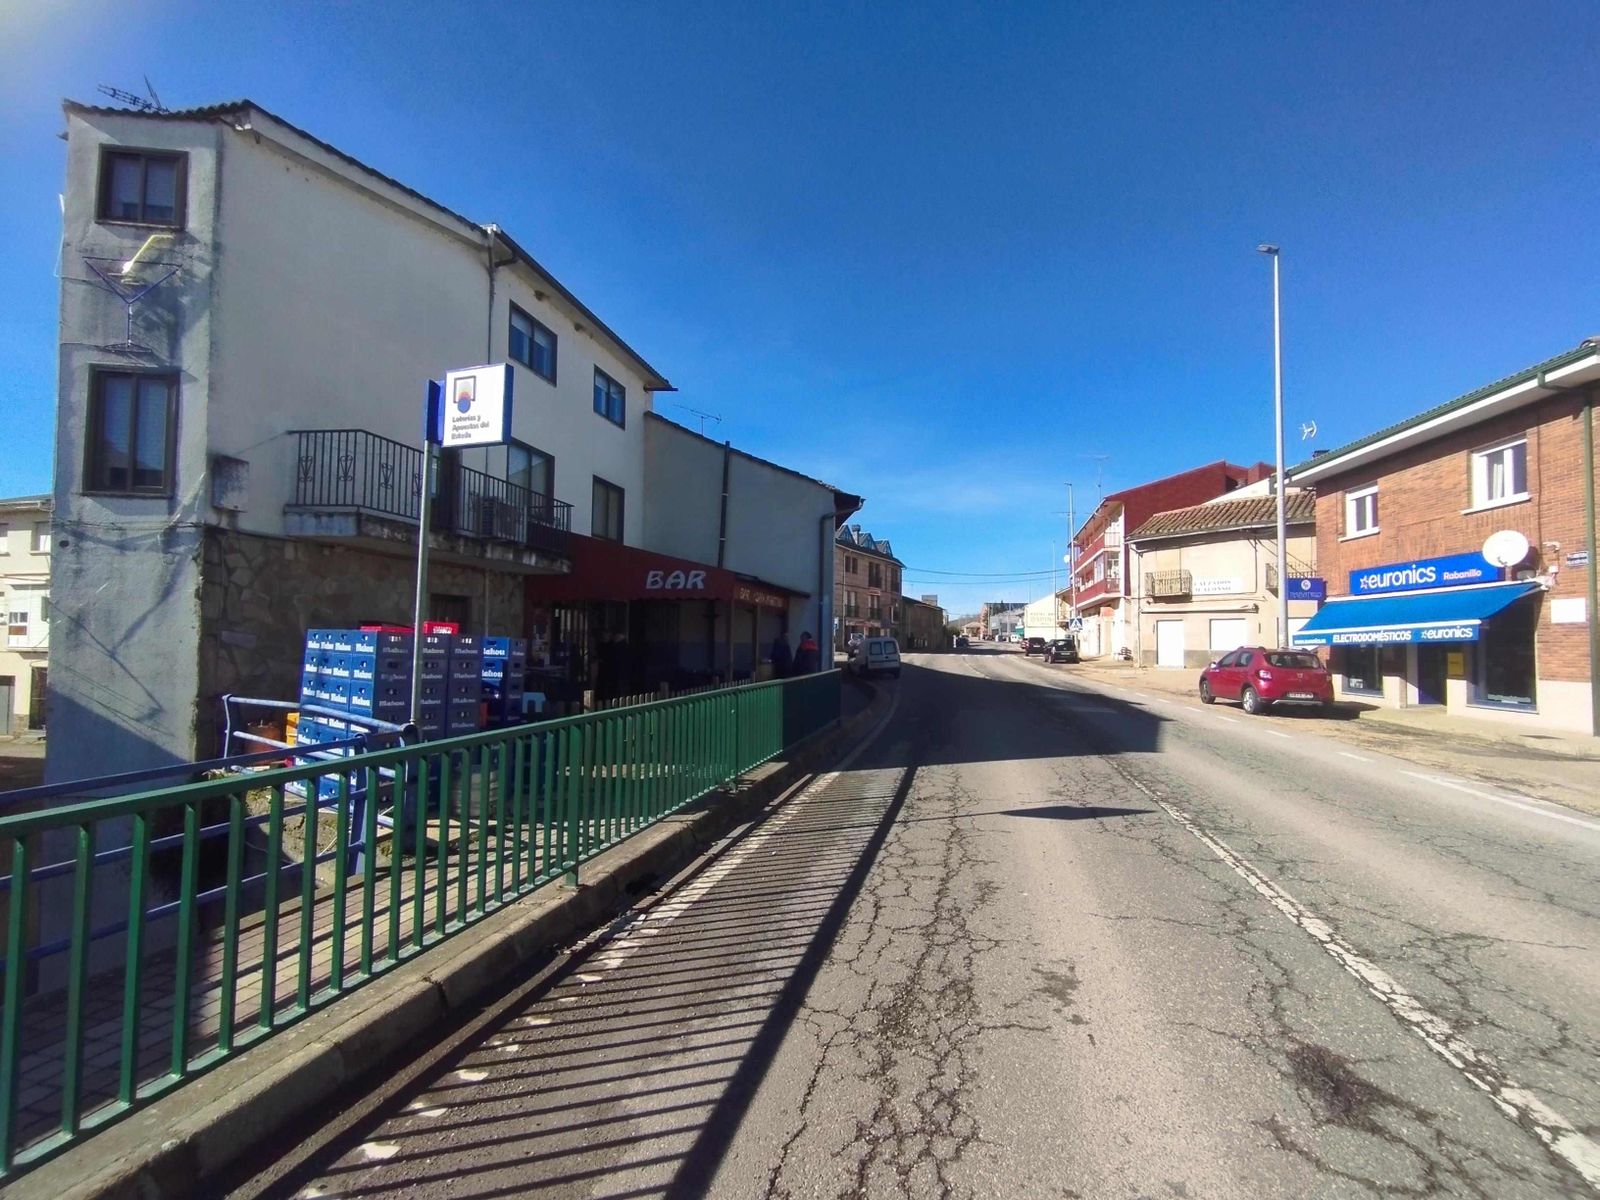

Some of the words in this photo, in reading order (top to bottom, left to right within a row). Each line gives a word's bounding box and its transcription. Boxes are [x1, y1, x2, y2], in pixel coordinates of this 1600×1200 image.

[645, 570, 706, 590] BAR
[1368, 564, 1436, 589] euronics
[1443, 569, 1482, 580] Rabanillo
[1332, 630, 1412, 643] ELECTRODOMÉSTICOS
[1427, 627, 1473, 639] euronics
[483, 647, 505, 656] ahou
[482, 669, 503, 678] ahou
